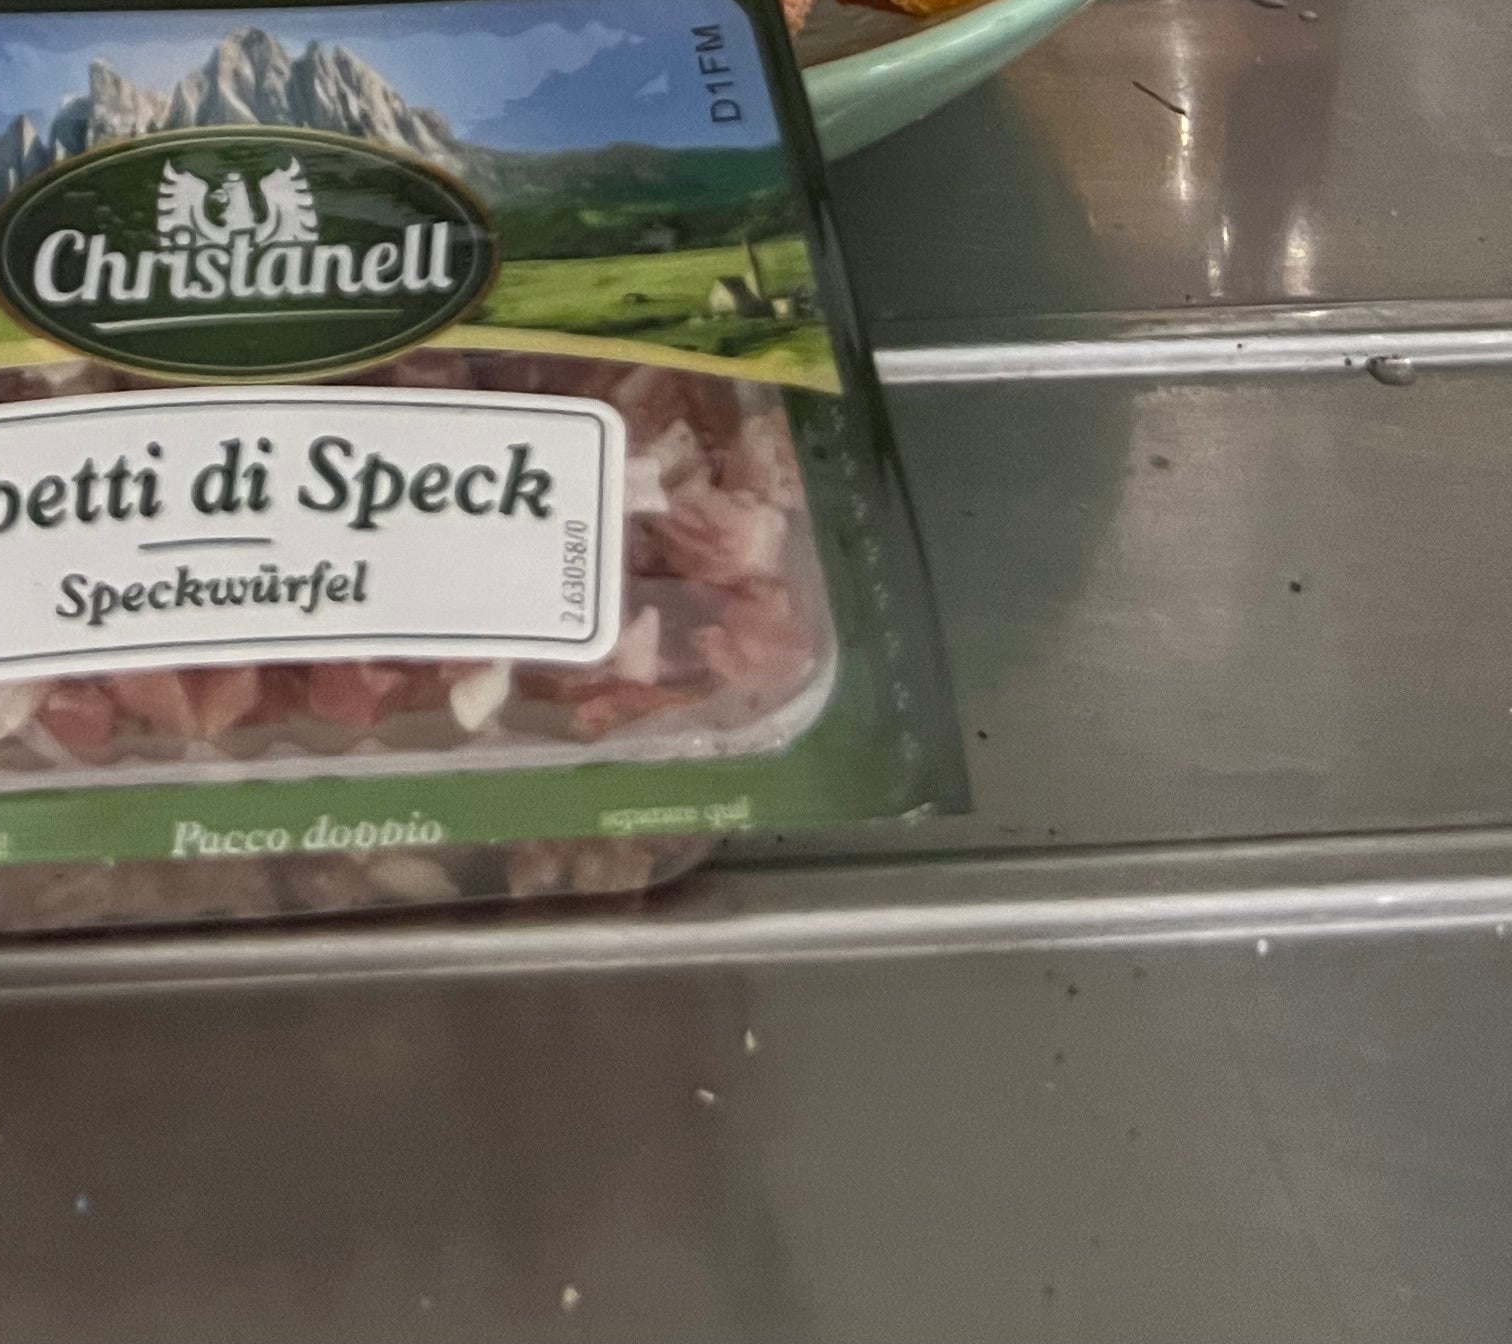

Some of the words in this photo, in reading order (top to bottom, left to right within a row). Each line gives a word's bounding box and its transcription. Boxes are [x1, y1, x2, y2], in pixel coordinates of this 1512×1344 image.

[691, 23, 742, 123] D1FM
[33, 220, 455, 304] Christanell
[189, 436, 274, 515] di
[297, 434, 553, 530] Speck
[55, 560, 370, 627] Speckwürfel
[170, 819, 290, 857] Pacco
